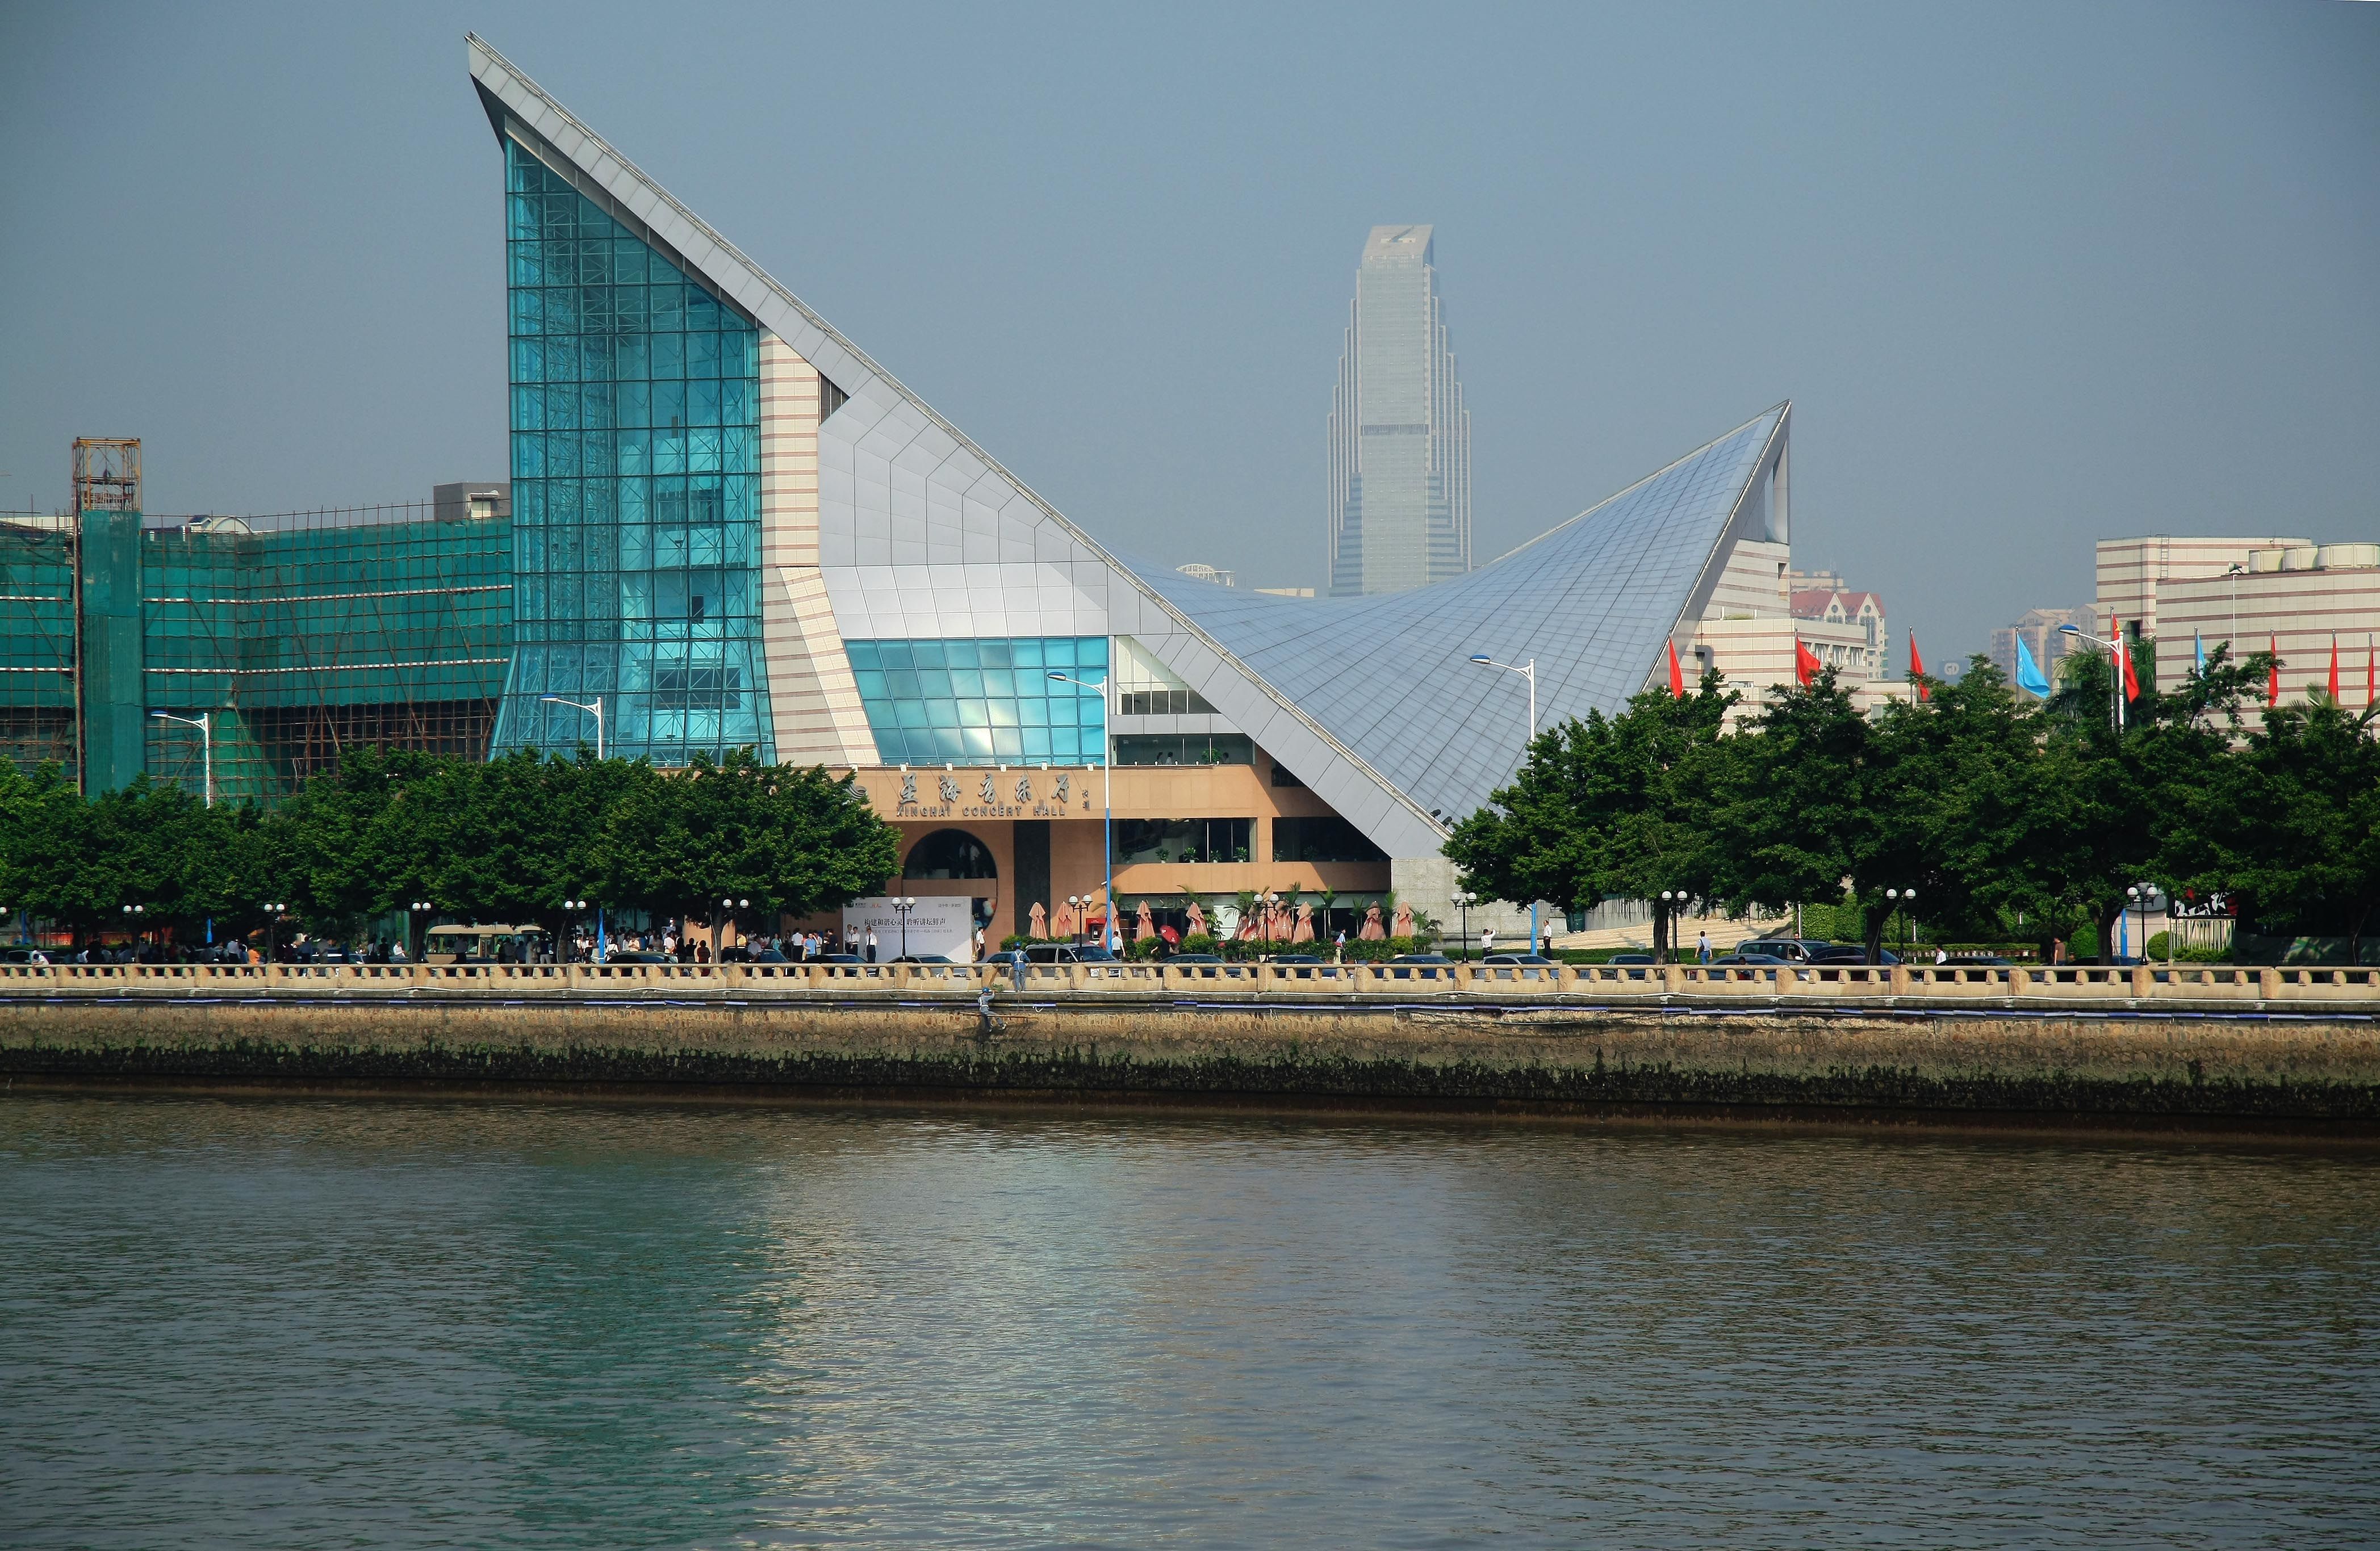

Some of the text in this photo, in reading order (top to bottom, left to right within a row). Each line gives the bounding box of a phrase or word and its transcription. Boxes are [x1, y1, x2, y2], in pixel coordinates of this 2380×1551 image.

[896, 804, 1066, 817] XINGHAI CONCERT HALL
